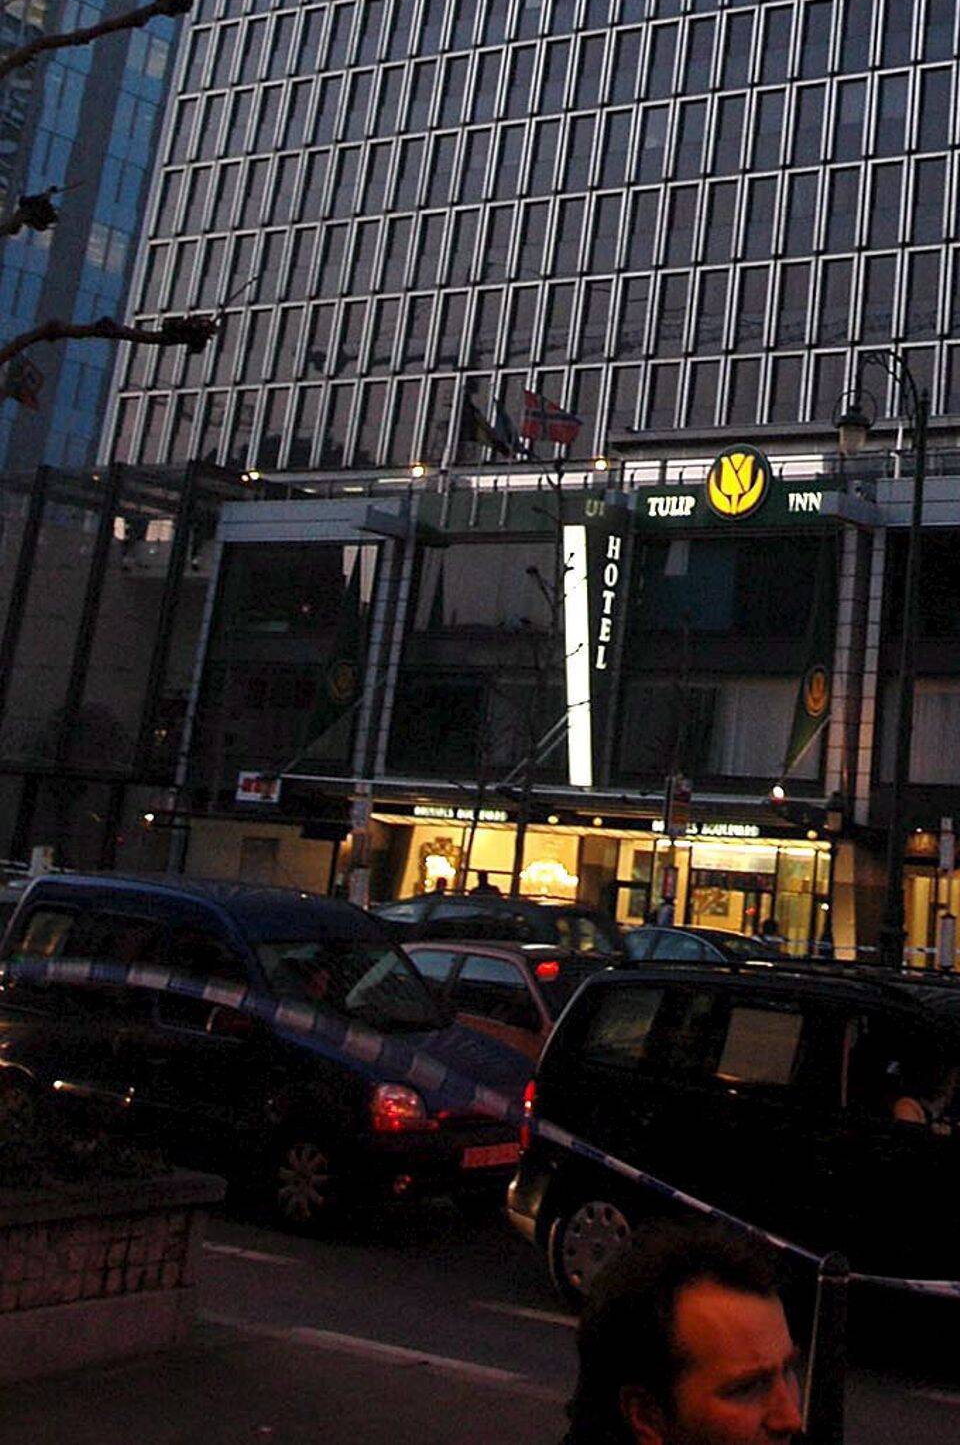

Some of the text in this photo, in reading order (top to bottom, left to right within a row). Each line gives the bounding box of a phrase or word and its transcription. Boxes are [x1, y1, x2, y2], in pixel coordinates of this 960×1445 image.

[647, 492, 823, 517] TULIP INN
[595, 535, 622, 670] HOTEL
